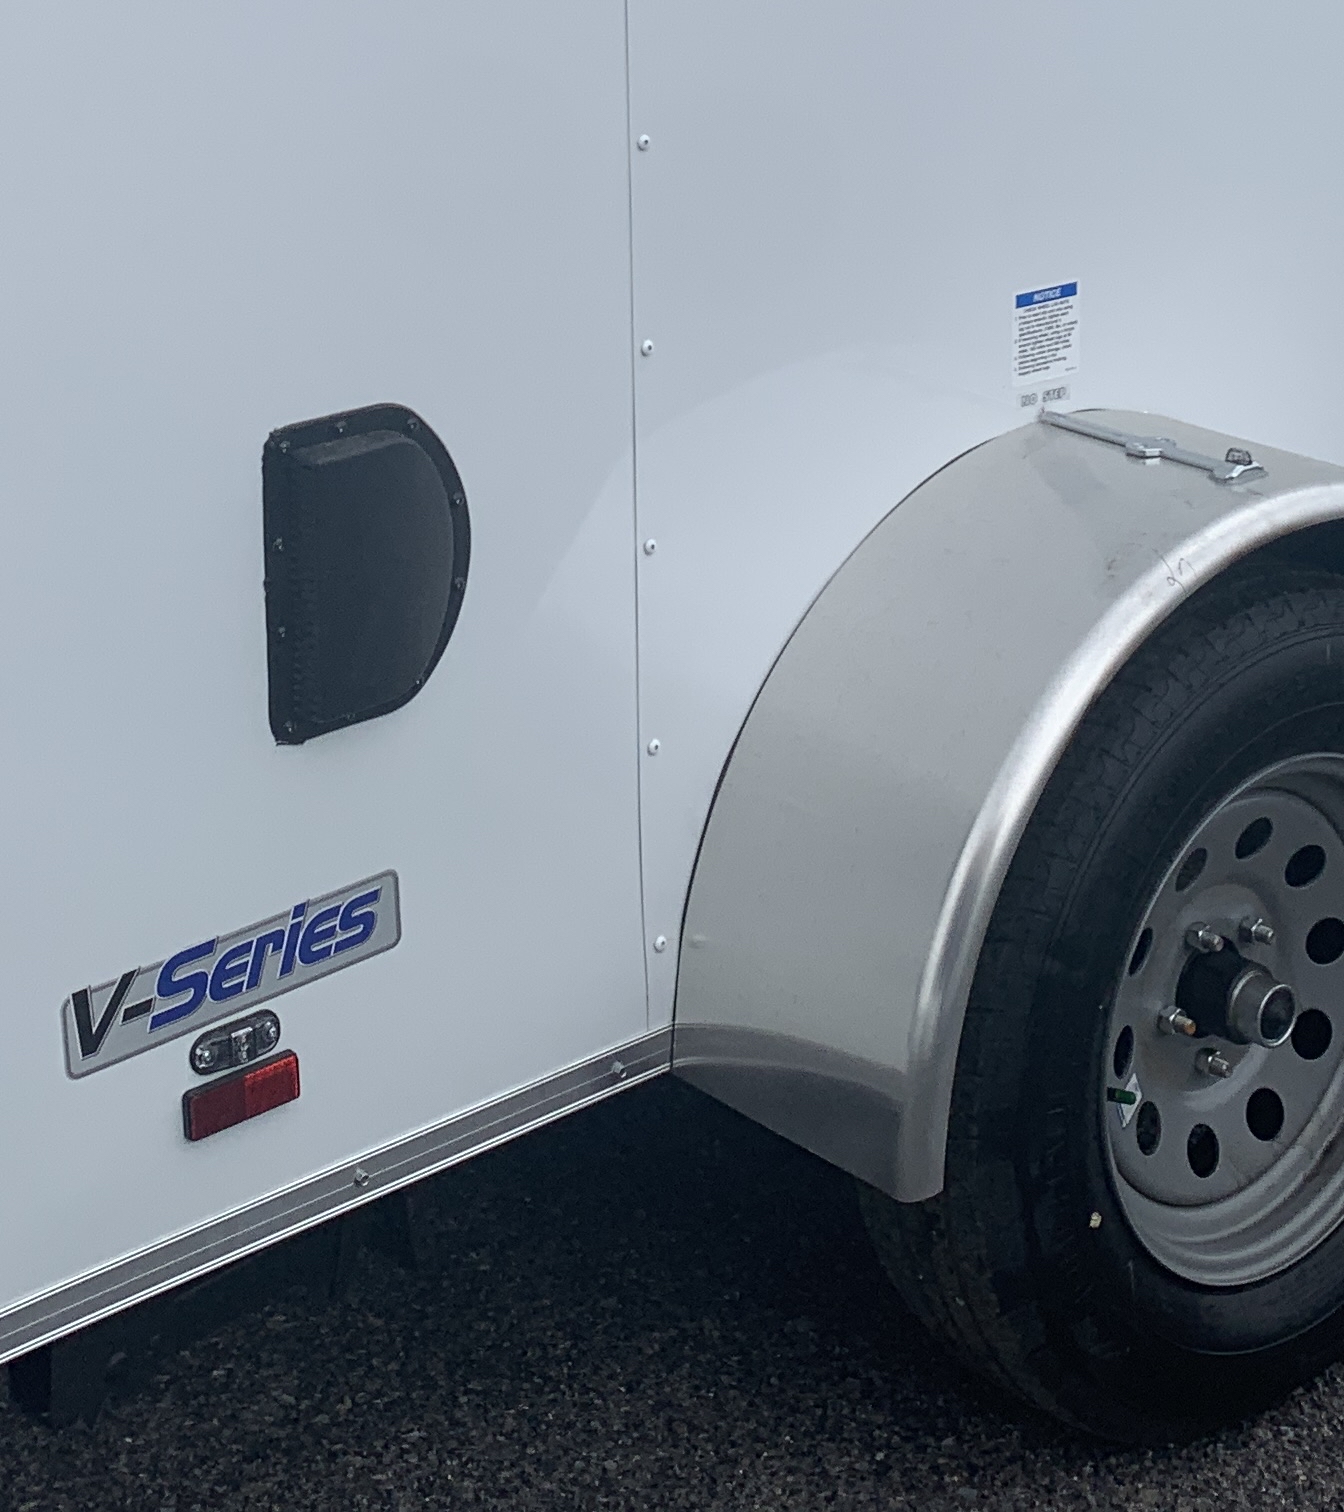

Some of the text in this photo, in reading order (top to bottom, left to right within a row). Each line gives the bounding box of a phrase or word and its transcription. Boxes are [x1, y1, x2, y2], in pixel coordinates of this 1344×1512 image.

[1033, 288, 1062, 302] NOTICE
[1021, 386, 1068, 407] NO STEP
[70, 885, 383, 1061] V-Series
